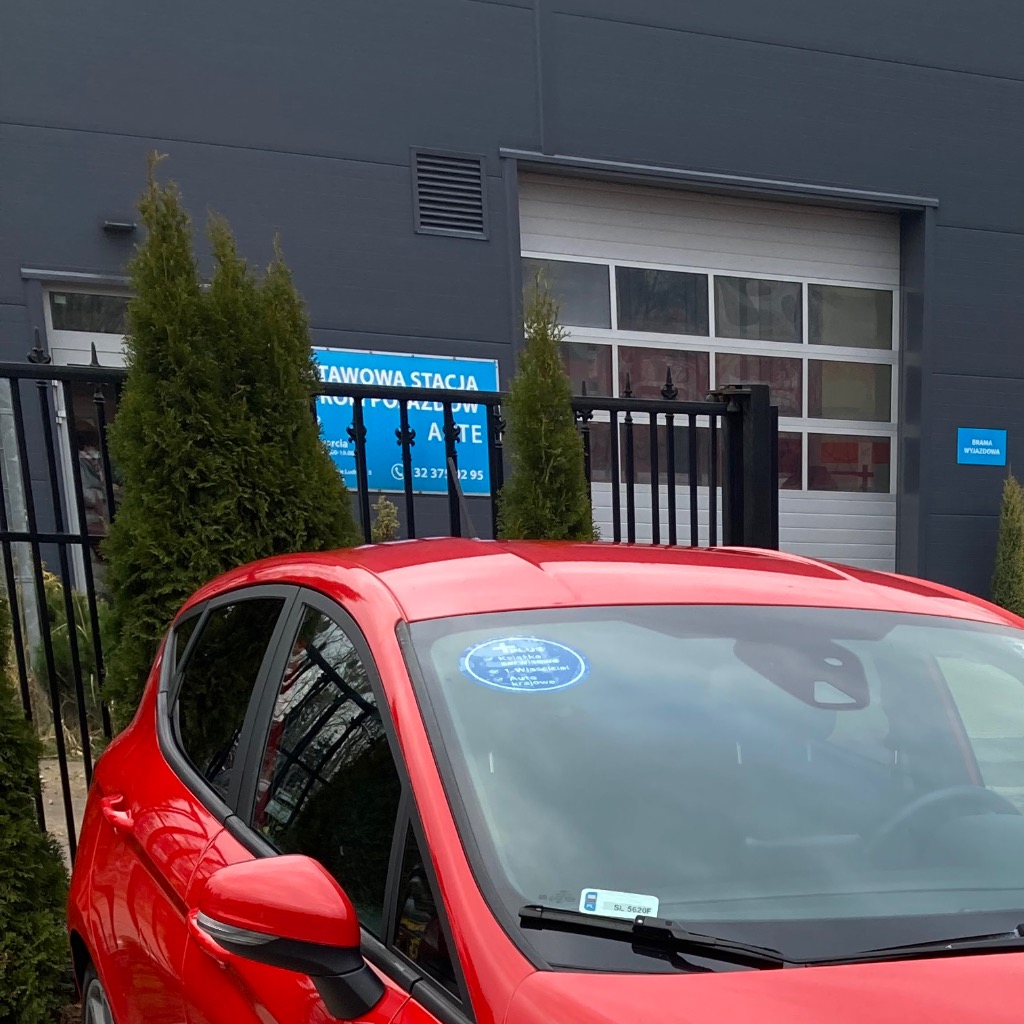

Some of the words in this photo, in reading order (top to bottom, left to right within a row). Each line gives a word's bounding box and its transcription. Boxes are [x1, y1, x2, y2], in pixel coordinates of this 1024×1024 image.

[411, 371, 478, 391] STACJA
[428, 422, 482, 443] ATE
[964, 447, 1001, 455] WYJAZDOWA
[414, 467, 428, 478] 32
[469, 469, 484, 480] 95
[613, 904, 624, 912] SL
[627, 905, 652, 914] 5620F
